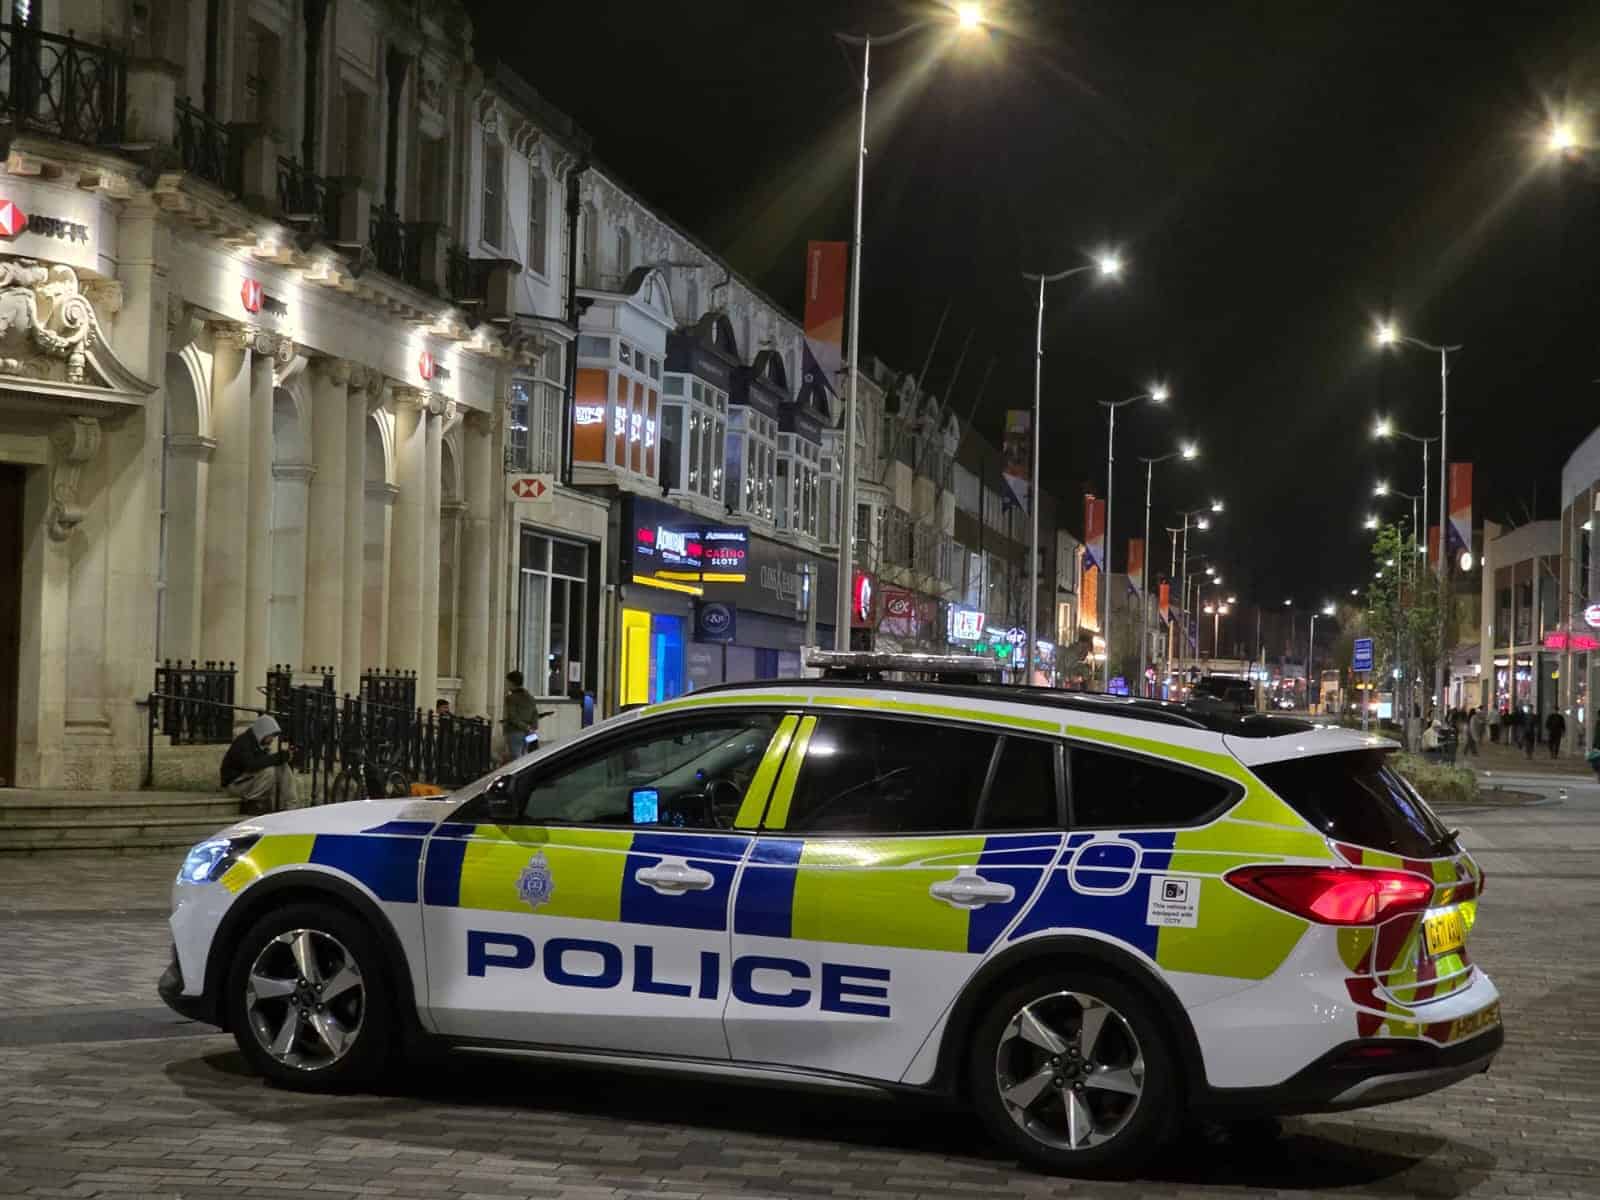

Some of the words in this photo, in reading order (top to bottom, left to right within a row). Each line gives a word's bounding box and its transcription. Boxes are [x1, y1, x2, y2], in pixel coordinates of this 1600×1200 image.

[704, 549, 745, 559] CASINO
[711, 558, 738, 567] SLOTS
[467, 930, 891, 1018] POLICE
